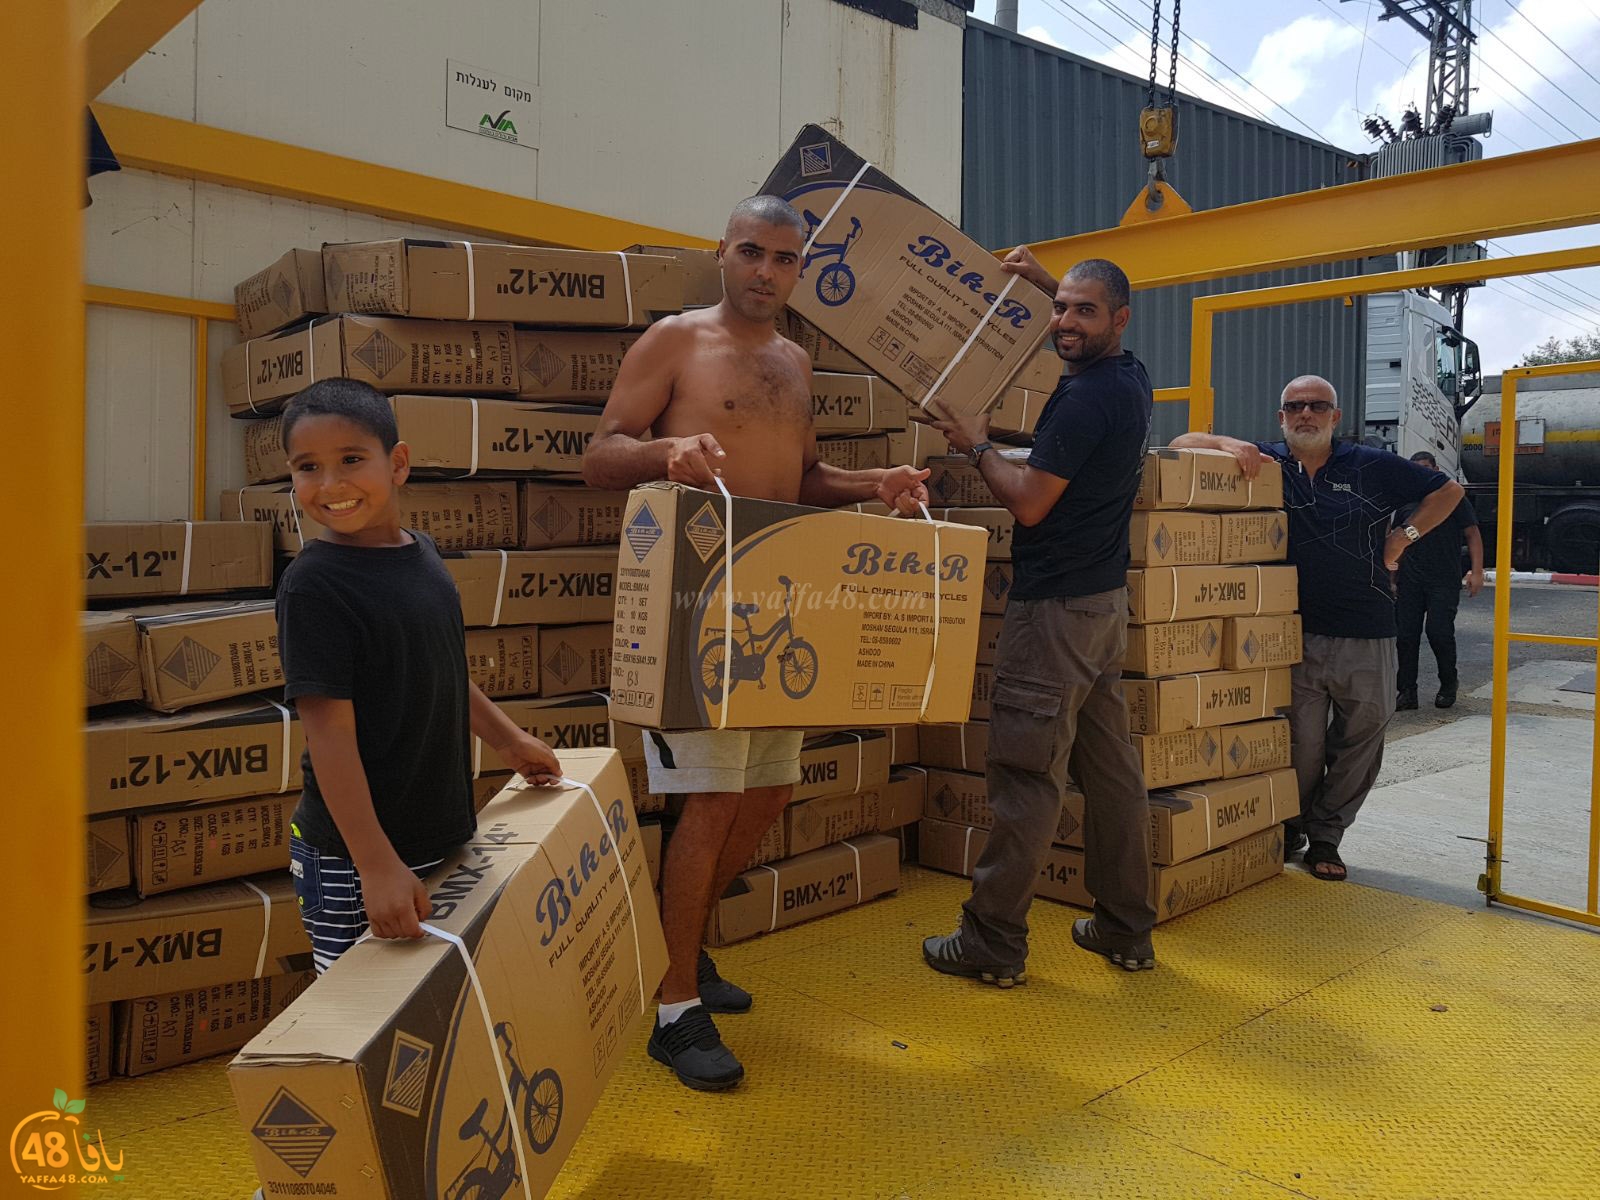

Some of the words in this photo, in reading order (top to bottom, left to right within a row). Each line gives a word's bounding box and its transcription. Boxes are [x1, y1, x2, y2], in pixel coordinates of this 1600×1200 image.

[456, 72, 496, 92] לעגלות
[504, 86, 531, 102] מקום
[497, 269, 605, 299] BMX-12"
[899, 255, 924, 277] FULL
[926, 274, 969, 308] QUALITY
[257, 350, 303, 384] BMX-12"
[1200, 471, 1241, 492] BMX-14"
[841, 543, 968, 582] BikeR
[508, 573, 612, 597] BMX-12"
[841, 584, 869, 594] FULL
[872, 587, 919, 597] QUALITY
[1195, 582, 1245, 603] BMX-14"
[639, 597, 648, 607] SET
[638, 612, 648, 621] KGS
[907, 614, 929, 623] IMPORT
[630, 624, 636, 633] 12
[637, 626, 646, 635] KGS
[884, 625, 907, 633] SEGULA
[256, 640, 265, 651] SET
[857, 660, 872, 668] MADE
[1206, 686, 1250, 710] BMX-14"
[110, 744, 267, 790] BMX-12"
[248, 807, 256, 823] QTY:
[1216, 797, 1260, 828] BMX-14"
[208, 814, 216, 838] COLOR:
[221, 843, 230, 856] KGS
[235, 841, 244, 854] KGS
[536, 799, 629, 947] BikeR
[782, 872, 853, 911] BMX-12"
[549, 934, 575, 968] FULL
[575, 882, 608, 932] QUALITY
[198, 991, 207, 1014] COLOR:
[210, 1019, 219, 1032] KGS
